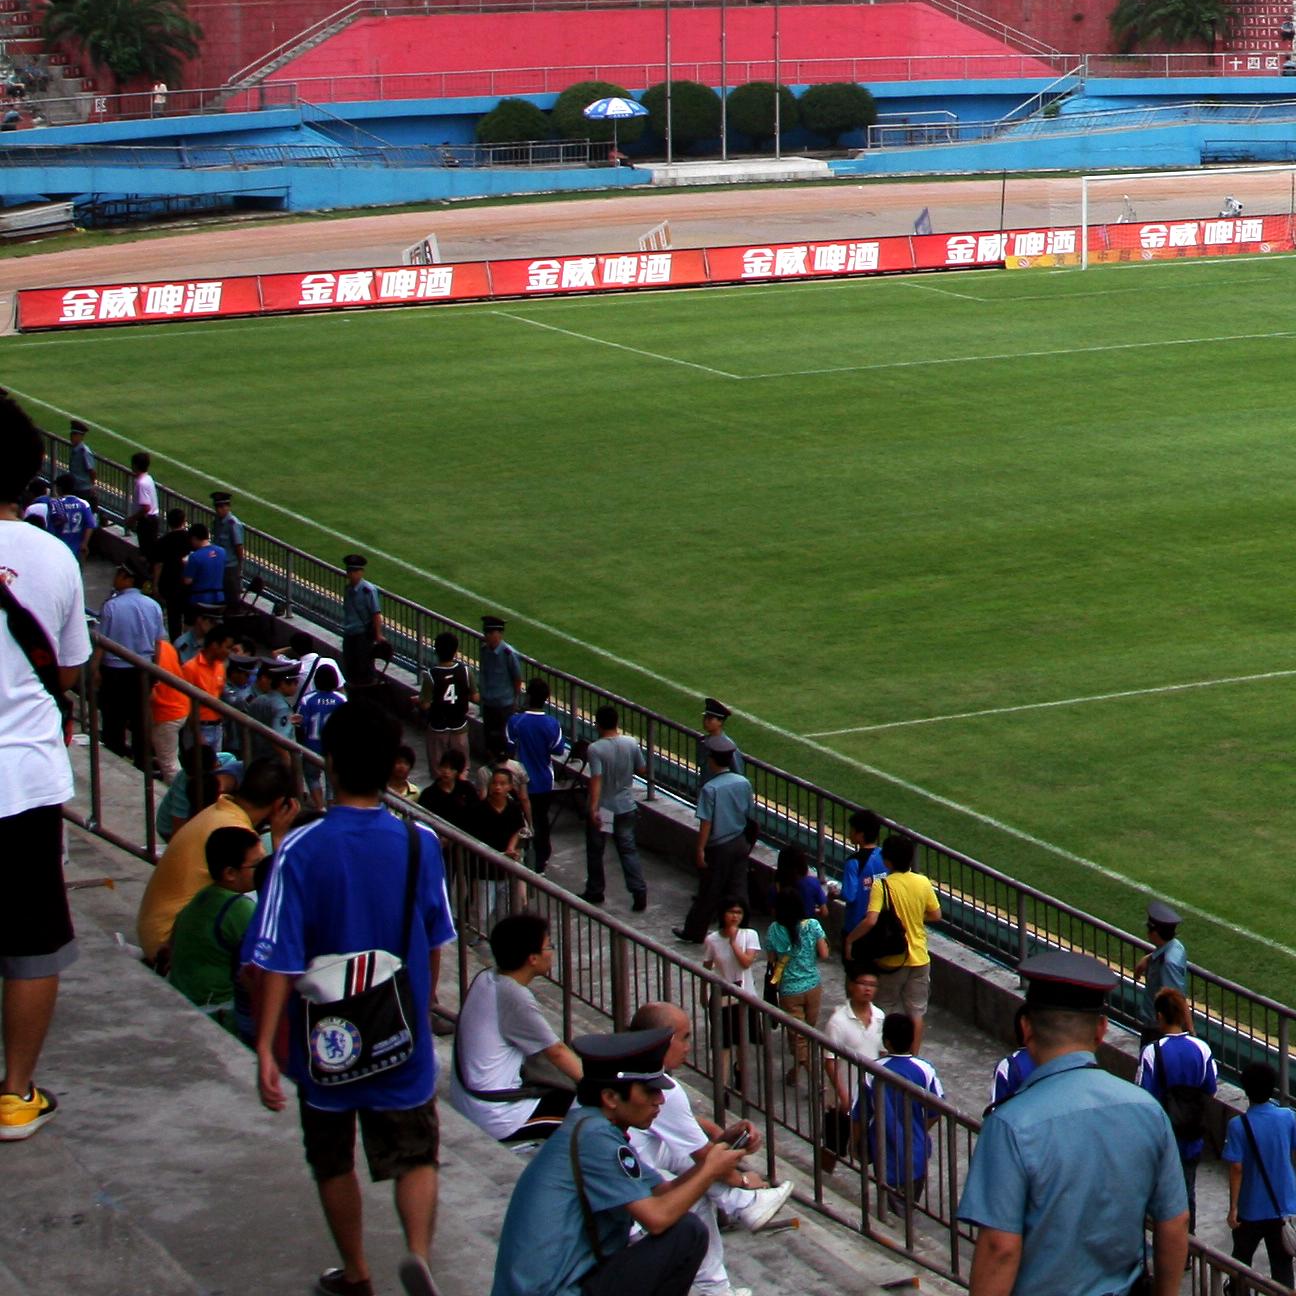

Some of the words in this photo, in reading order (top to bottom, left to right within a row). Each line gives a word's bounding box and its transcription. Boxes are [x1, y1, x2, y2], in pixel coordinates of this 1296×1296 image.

[1228, 56, 1280, 71] 十四区
[945, 230, 1075, 264] 金威啤酒
[1139, 219, 1263, 248] 金威啤酒
[526, 253, 672, 291] 金威啤酒
[742, 242, 879, 278] 金威啤酒
[59, 281, 223, 322] 金威啤酒
[298, 267, 453, 305] 金威啤酒
[443, 683, 458, 705] 4
